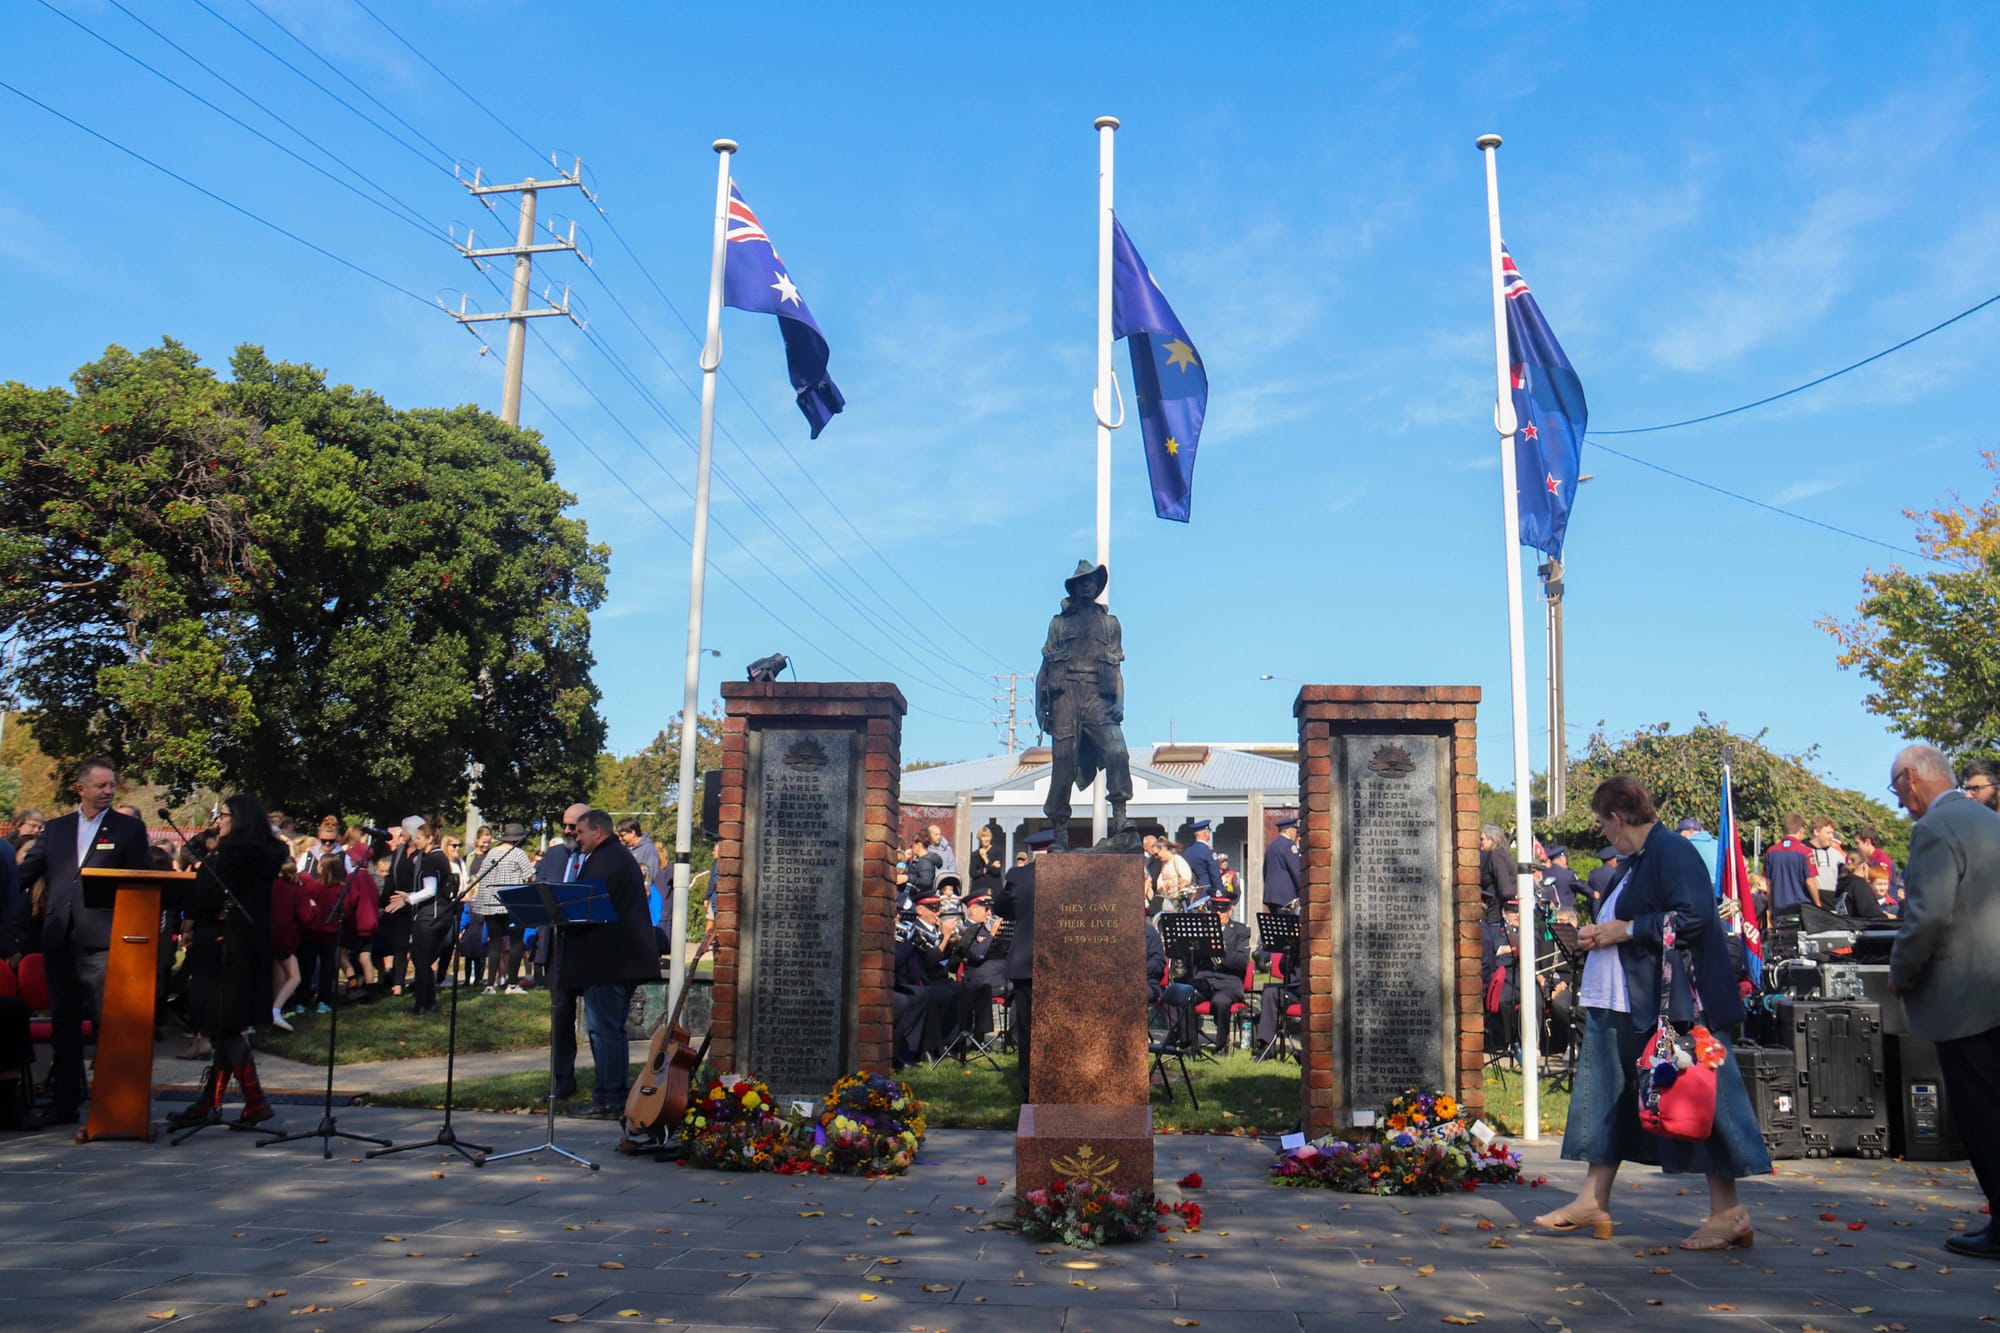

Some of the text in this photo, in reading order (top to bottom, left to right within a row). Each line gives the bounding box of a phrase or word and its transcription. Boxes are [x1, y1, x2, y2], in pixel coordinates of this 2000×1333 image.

[778, 885, 816, 893] CLARK
[776, 894, 816, 902] CLARK
[1060, 903, 1117, 912] THEY GAVE
[790, 912, 829, 920] CLARK
[1058, 920, 1119, 928] THEIR LIVES
[1368, 951, 1422, 959] ROBERTS
